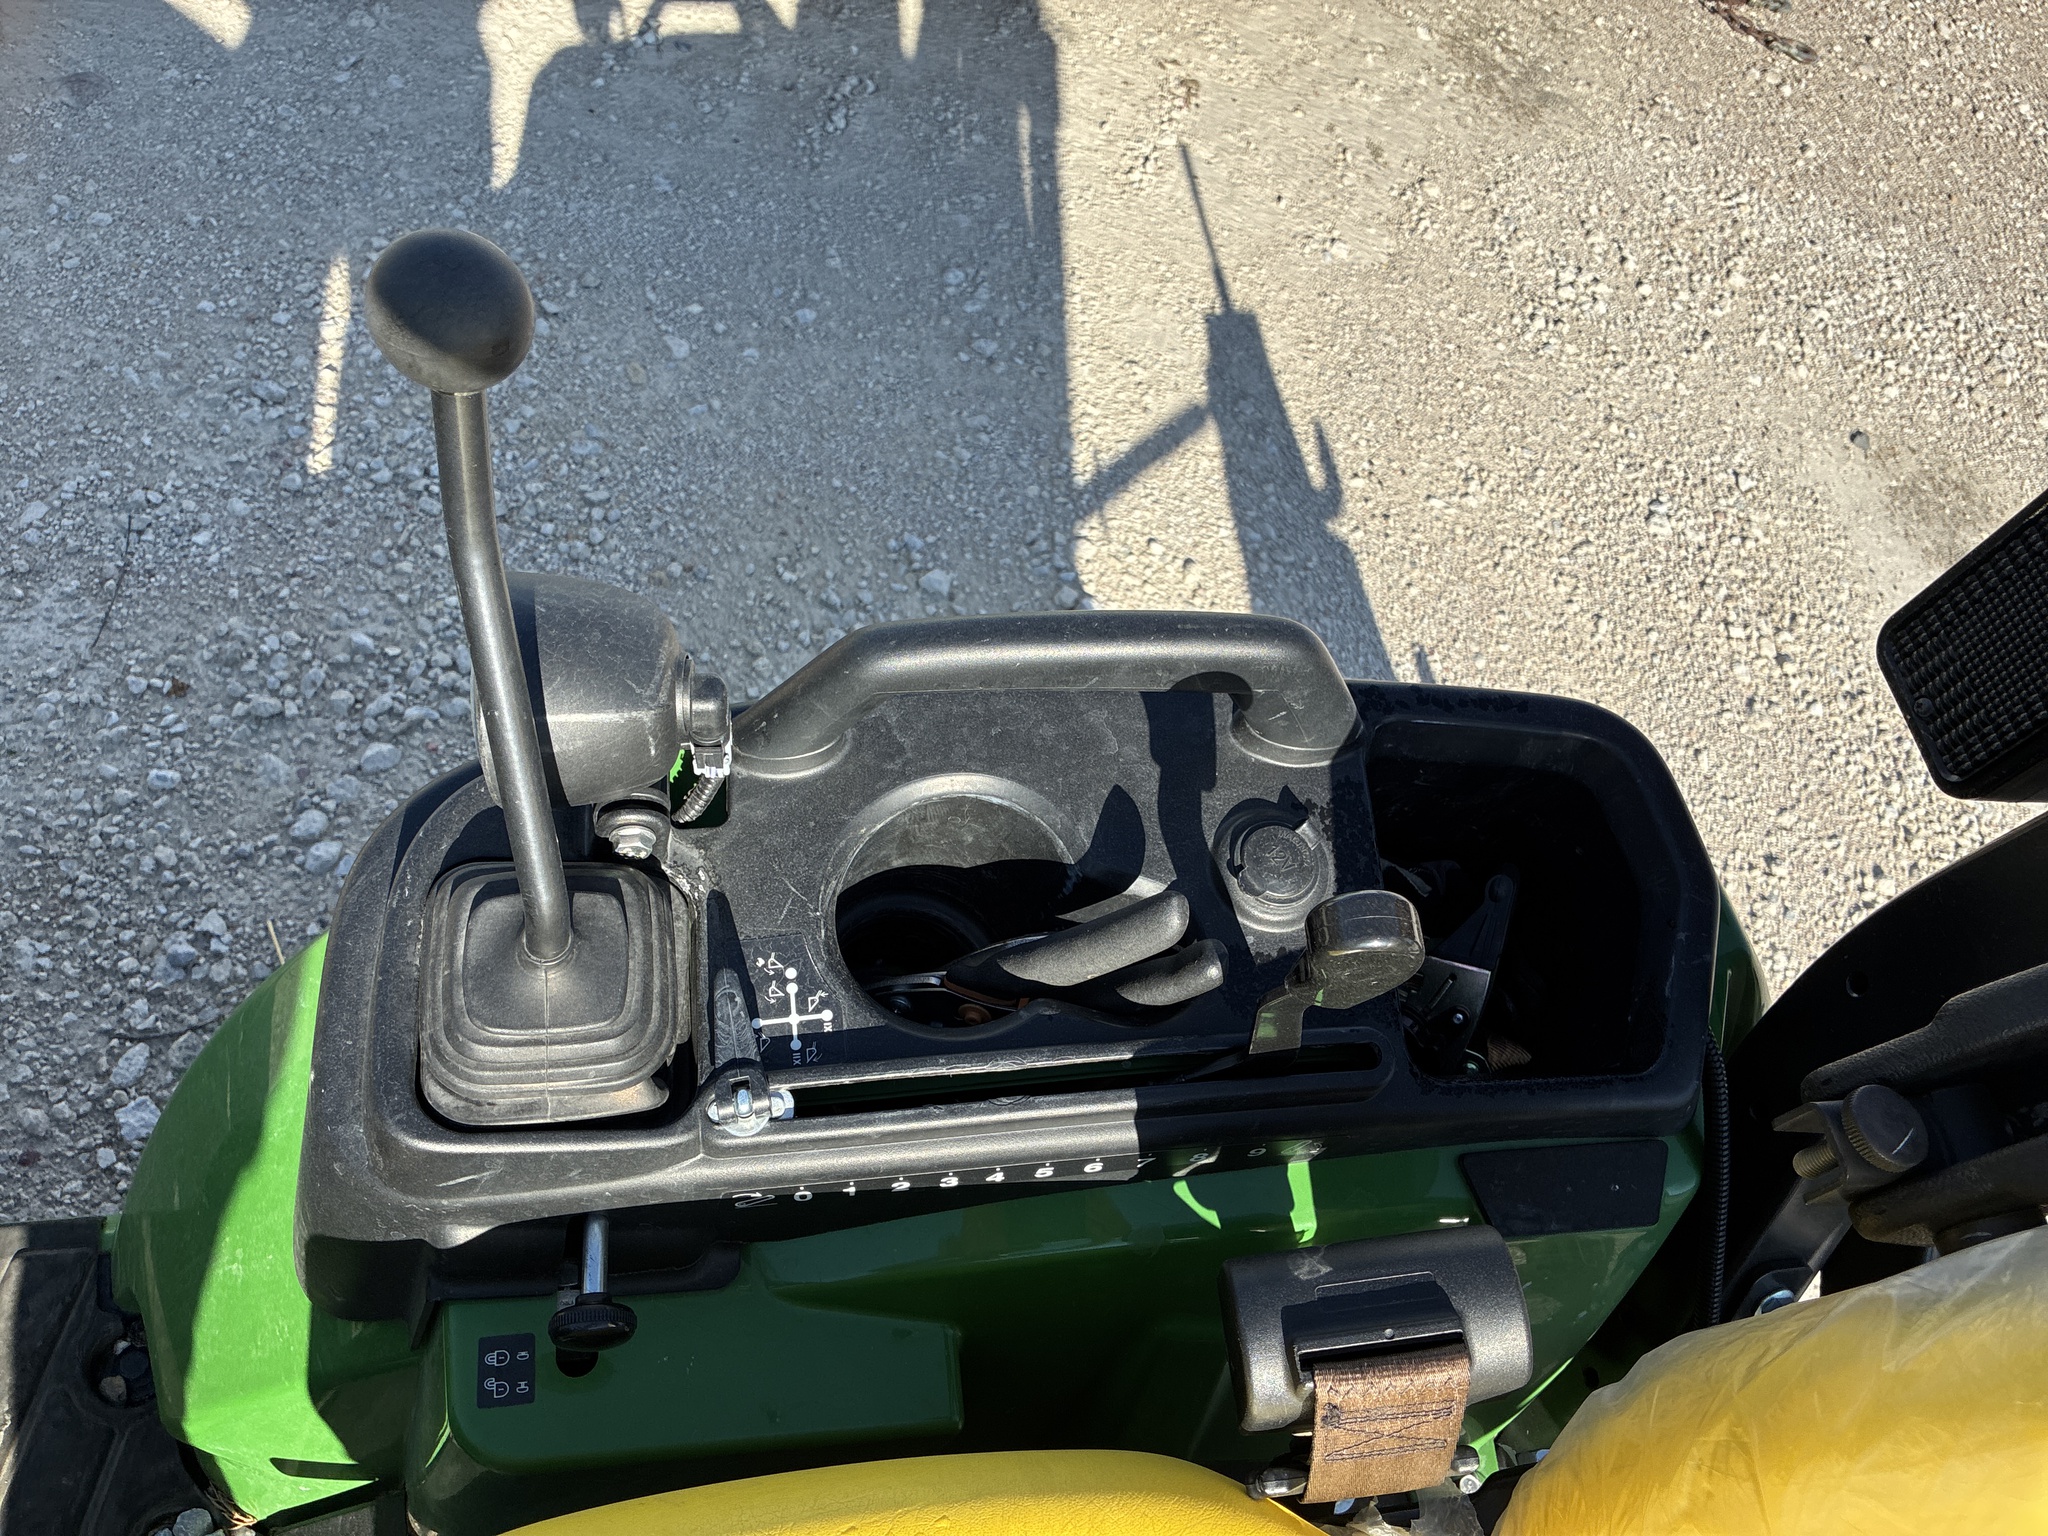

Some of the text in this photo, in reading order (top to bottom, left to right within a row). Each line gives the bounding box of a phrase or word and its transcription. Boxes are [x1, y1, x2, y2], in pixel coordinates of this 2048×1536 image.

[1265, 845, 1298, 873] 12V
[793, 1148, 1266, 1202] 0 1 2 3 4 5 6 7 8 9
